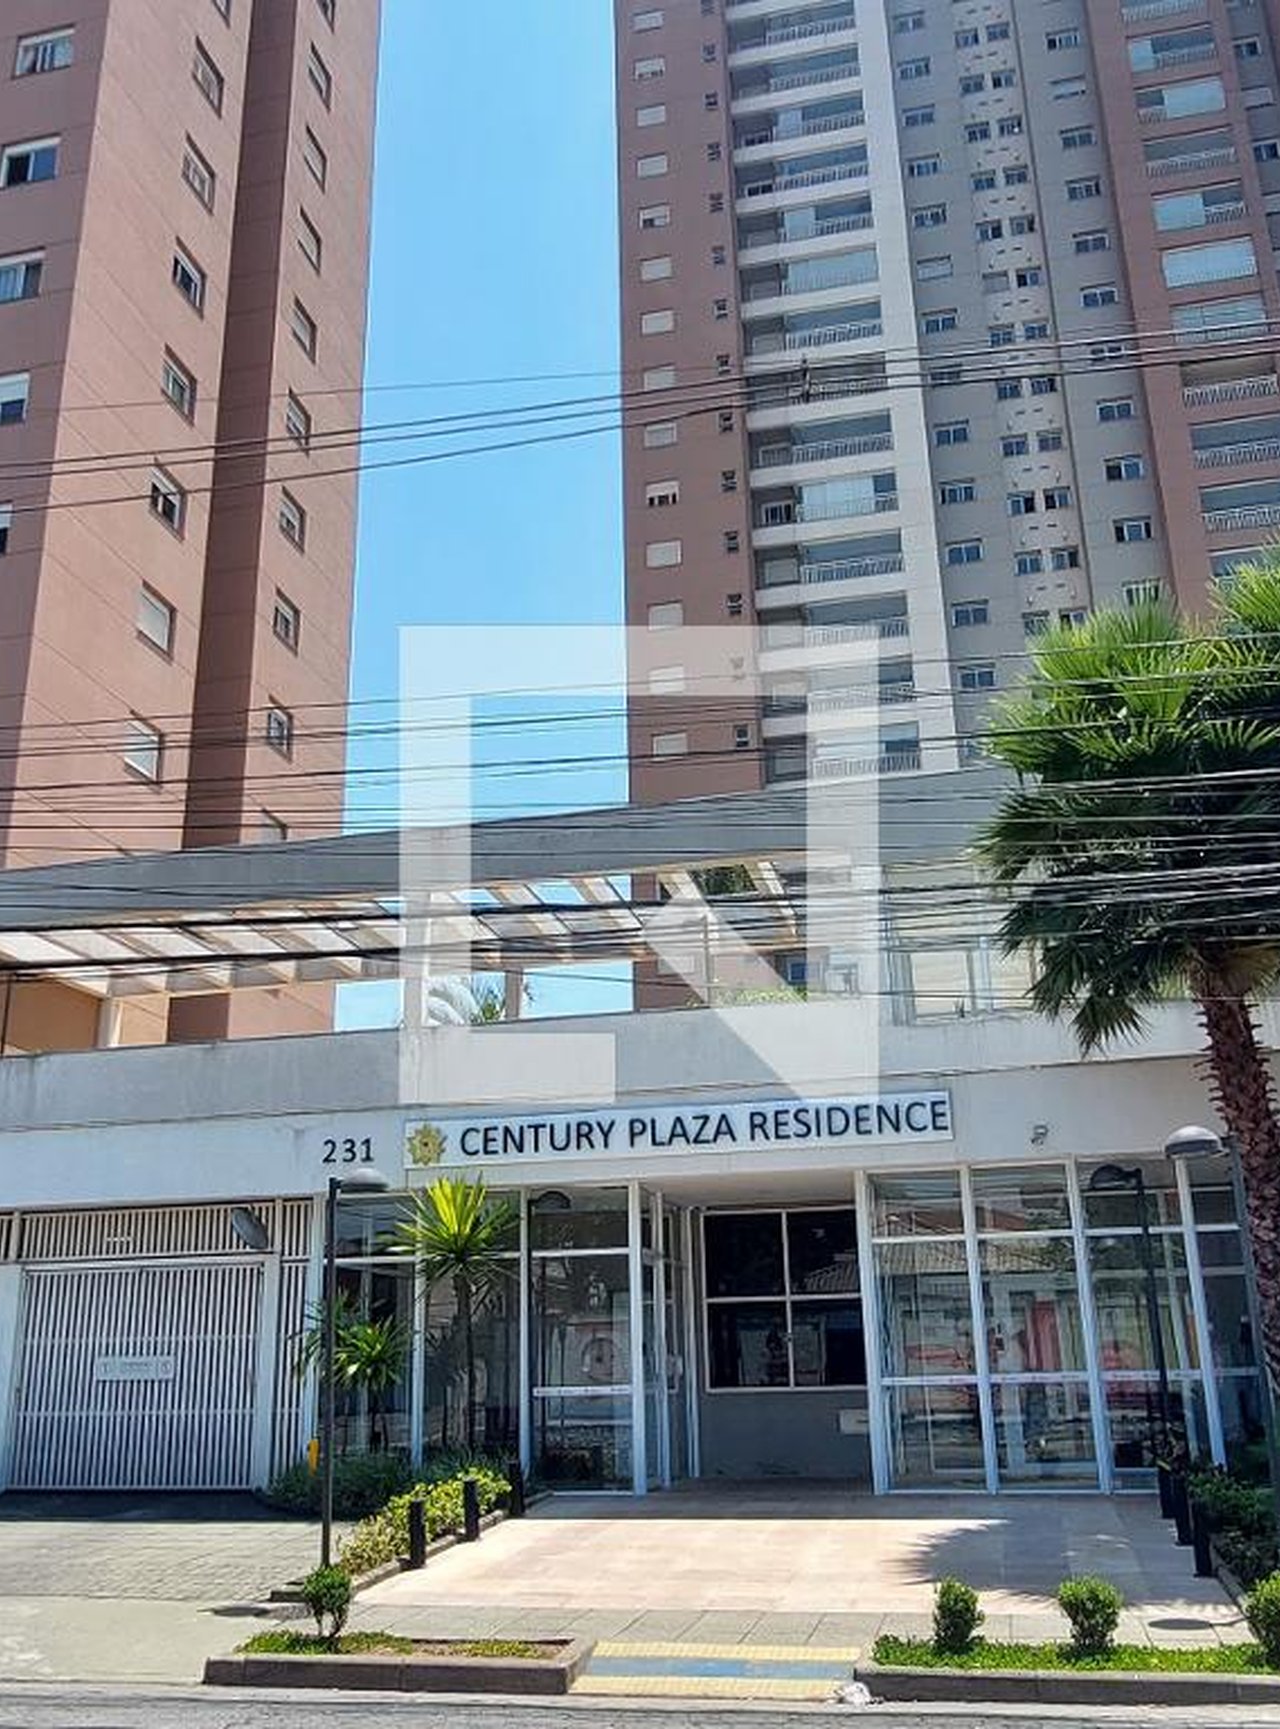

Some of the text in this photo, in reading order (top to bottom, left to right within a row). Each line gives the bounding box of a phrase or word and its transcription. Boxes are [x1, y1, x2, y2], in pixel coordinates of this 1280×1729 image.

[461, 1101, 948, 1155] CENTURY PLAZA RESIDENCE
[323, 1138, 373, 1162] 231
